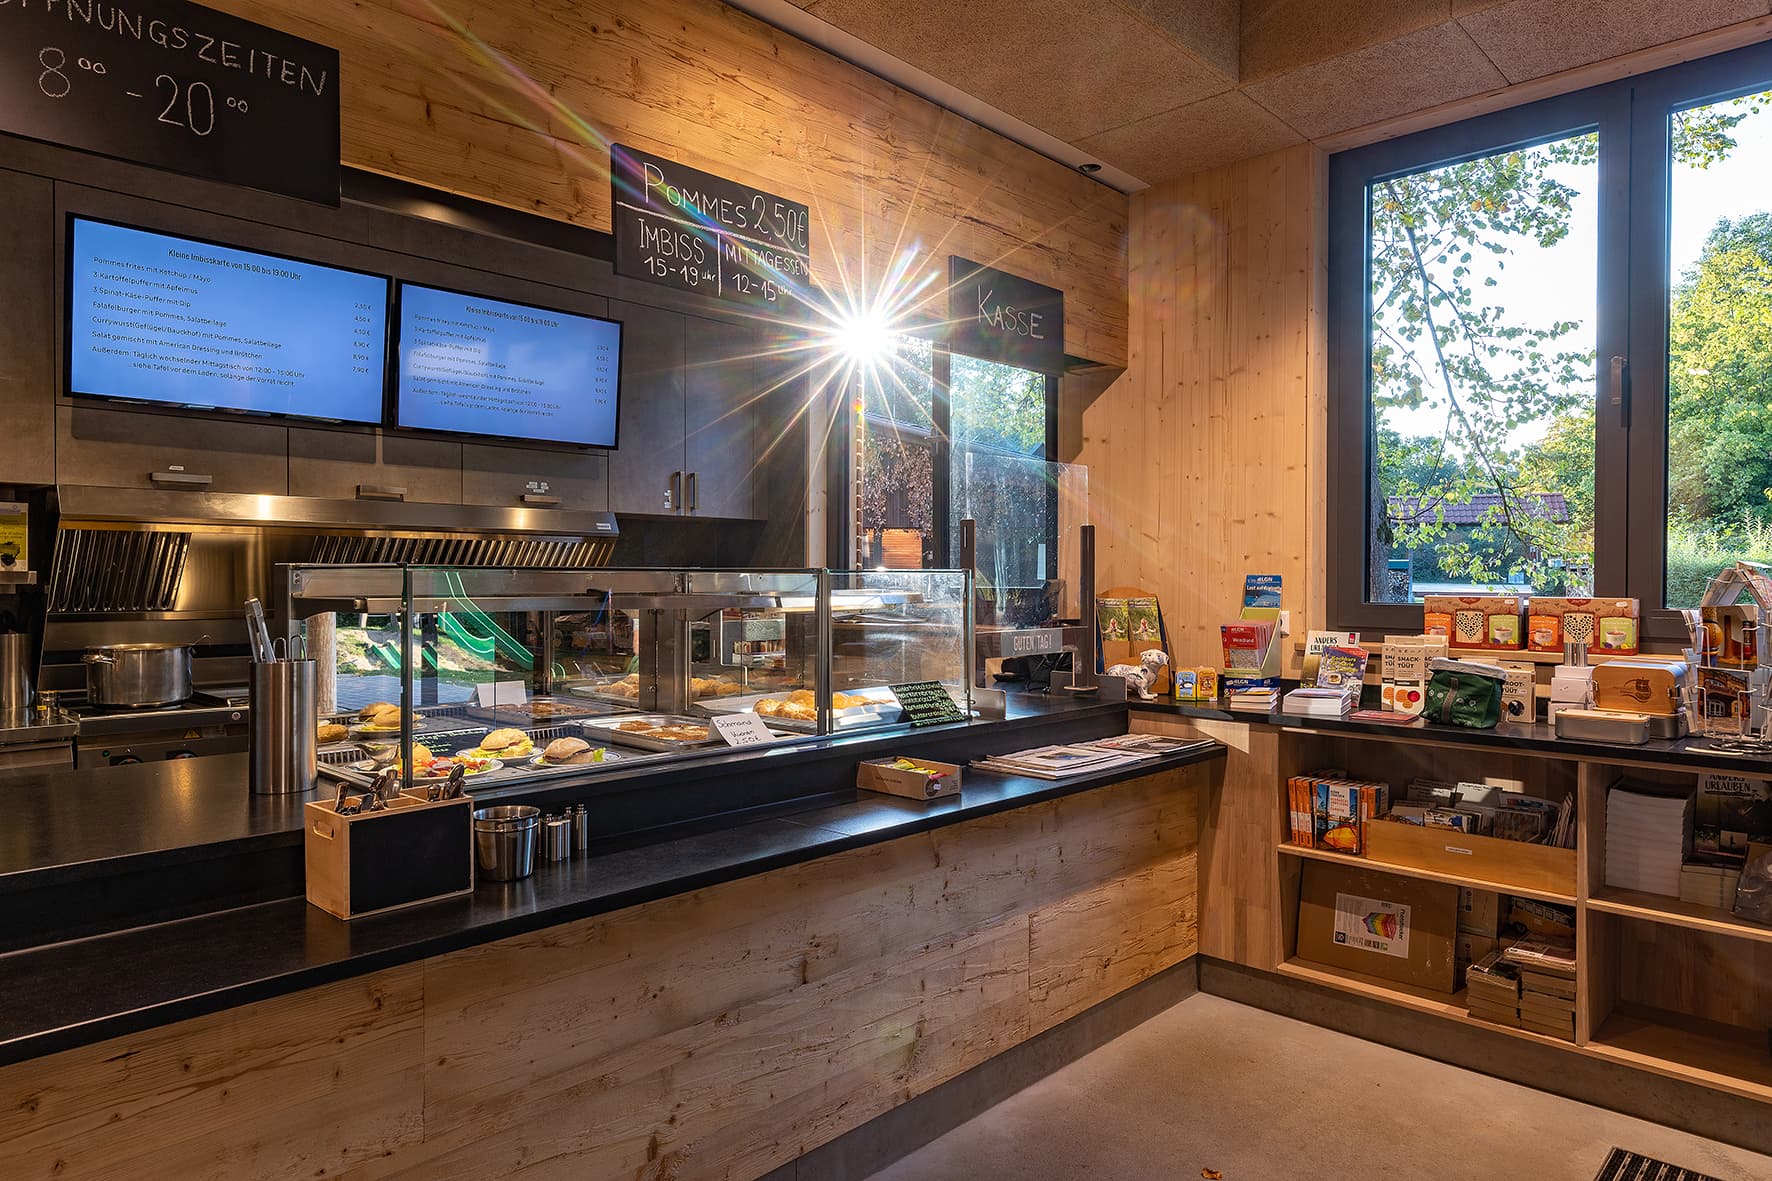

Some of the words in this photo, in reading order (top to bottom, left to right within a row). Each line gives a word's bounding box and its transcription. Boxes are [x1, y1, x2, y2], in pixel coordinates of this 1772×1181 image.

[0, 0, 327, 96] NUNGSZEITEN
[638, 218, 705, 264] IMBISS
[93, 255, 124, 268] Pommes
[125, 261, 144, 271] frites
[146, 265, 157, 274] mit
[158, 267, 187, 280] Ketchup
[192, 273, 210, 285] Mayo
[190, 252, 230, 268] Imbisskarte
[230, 260, 242, 270] von
[261, 266, 271, 275] bis
[289, 271, 301, 281] Uhr
[725, 243, 809, 276] MITTAGESSEN
[99, 271, 152, 289] Kartoffelpuffer
[153, 280, 164, 289] mit
[165, 283, 198, 296] Apfelmus
[92, 300, 141, 316] Falafelburger
[142, 308, 153, 316] mit
[154, 310, 185, 323] Pommes,
[186, 314, 226, 329] Salatbeilage
[166, 297, 178, 306] mit
[179, 299, 190, 309] Dip
[977, 284, 1044, 340] KASSE
[91, 330, 110, 339] Salat
[111, 332, 145, 345] gemischt
[145, 337, 157, 345] mit
[158, 339, 190, 350] American
[191, 343, 219, 355] Dressing
[220, 347, 233, 355] und
[201, 331, 213, 339] mit
[214, 333, 243, 345] Pommes,
[243, 337, 281, 350] Salatbeilage
[132, 350, 157, 362] Täglich
[158, 353, 201, 365] wechselnder
[201, 359, 241, 372] Mittagstisch
[153, 363, 169, 372] Tafel
[169, 365, 181, 373] vor
[181, 367, 196, 375] dem
[219, 371, 244, 382] solange
[256, 376, 276, 384] Vorrat
[1013, 635, 1036, 652] GUTEN
[1036, 633, 1052, 650] TAG!
[1314, 636, 1338, 645] ANDERS
[1704, 781, 1751, 793] URLAUBEN
